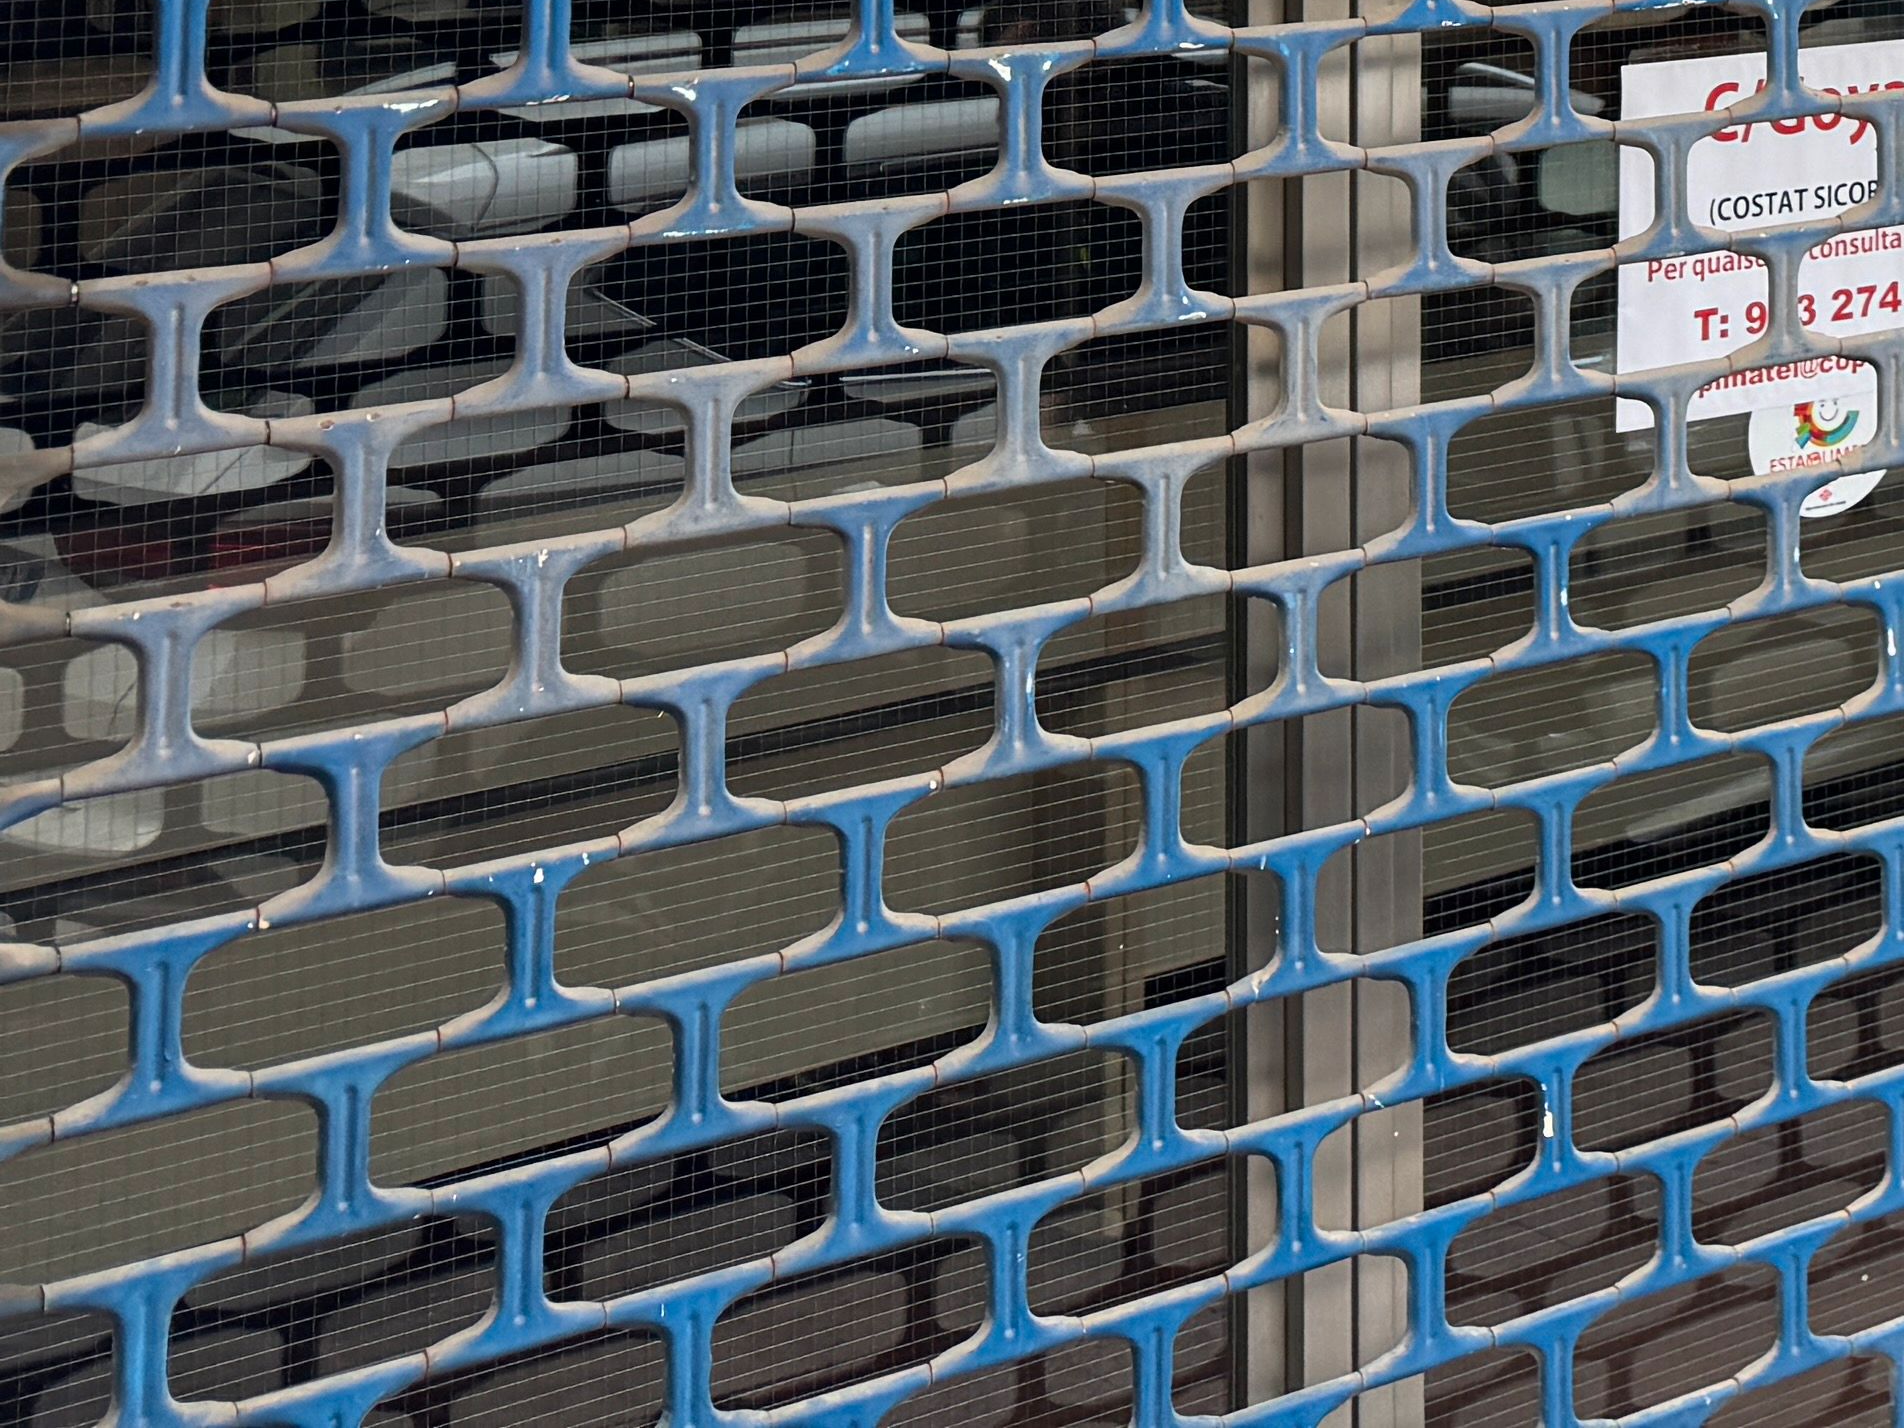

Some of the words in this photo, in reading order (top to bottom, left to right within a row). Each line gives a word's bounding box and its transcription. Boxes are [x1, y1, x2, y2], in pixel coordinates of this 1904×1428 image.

[1709, 188, 1809, 225] (COSTAT
[1648, 260, 1687, 282] Per
[1809, 228, 1902, 260] consulta
[1694, 307, 1729, 341] T:
[1745, 293, 1817, 334] 93
[1831, 282, 1902, 322] 274
